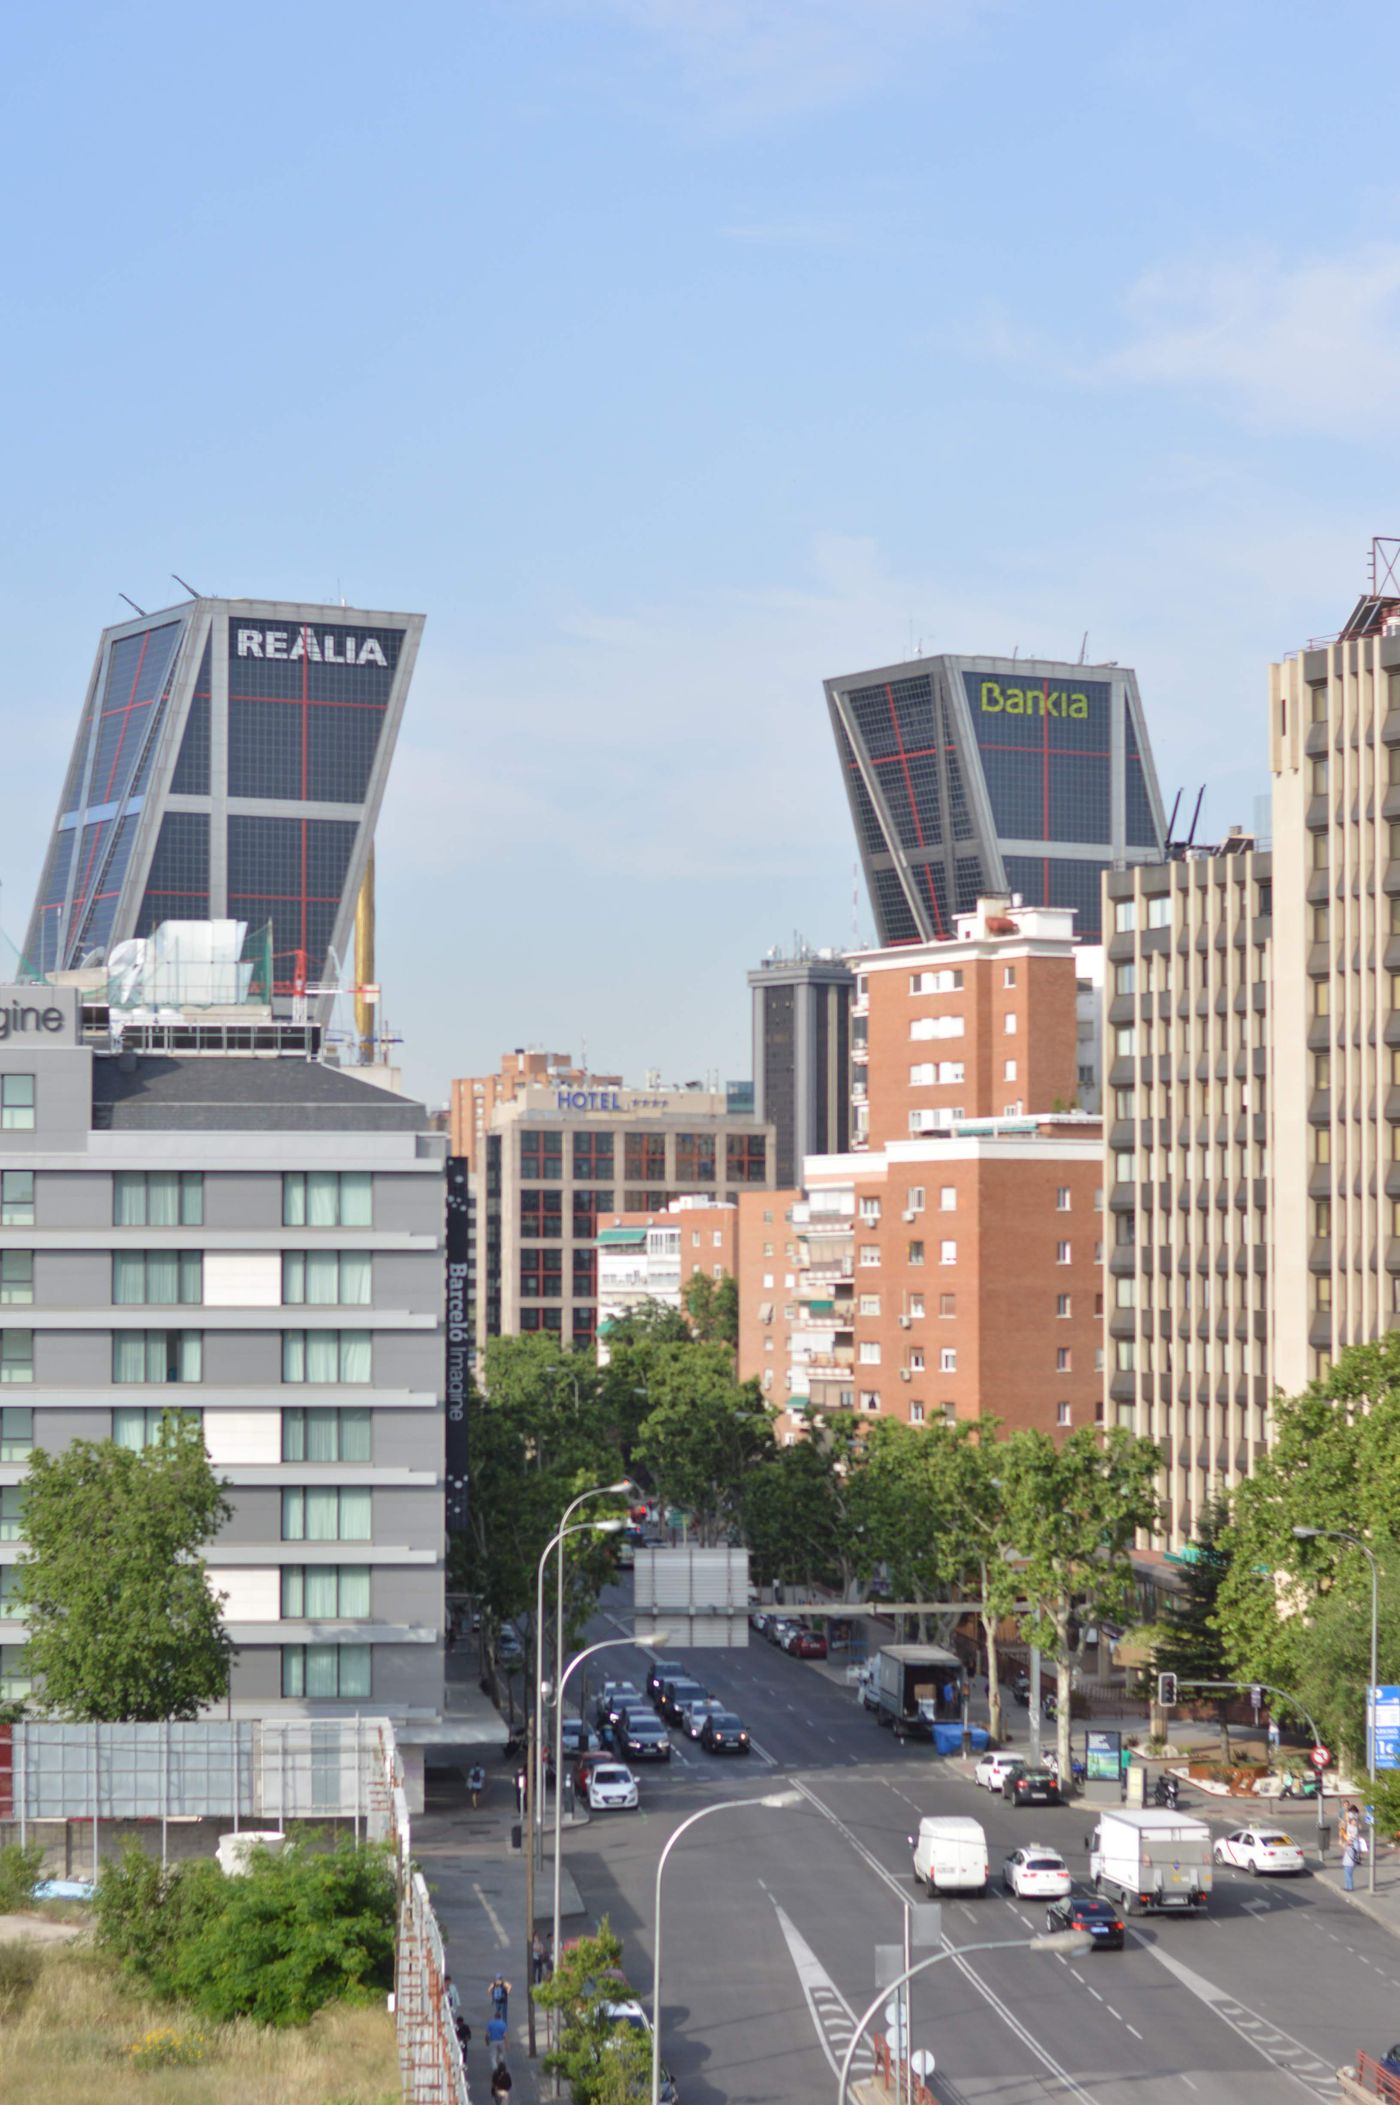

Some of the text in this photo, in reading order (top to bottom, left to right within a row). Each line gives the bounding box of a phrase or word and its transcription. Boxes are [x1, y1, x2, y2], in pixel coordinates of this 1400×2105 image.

[237, 627, 388, 667] REALIA
[980, 681, 1089, 719] Bankia
[558, 1091, 622, 1111] HOTEL
[448, 1263, 469, 1421] Barceló Imagine
